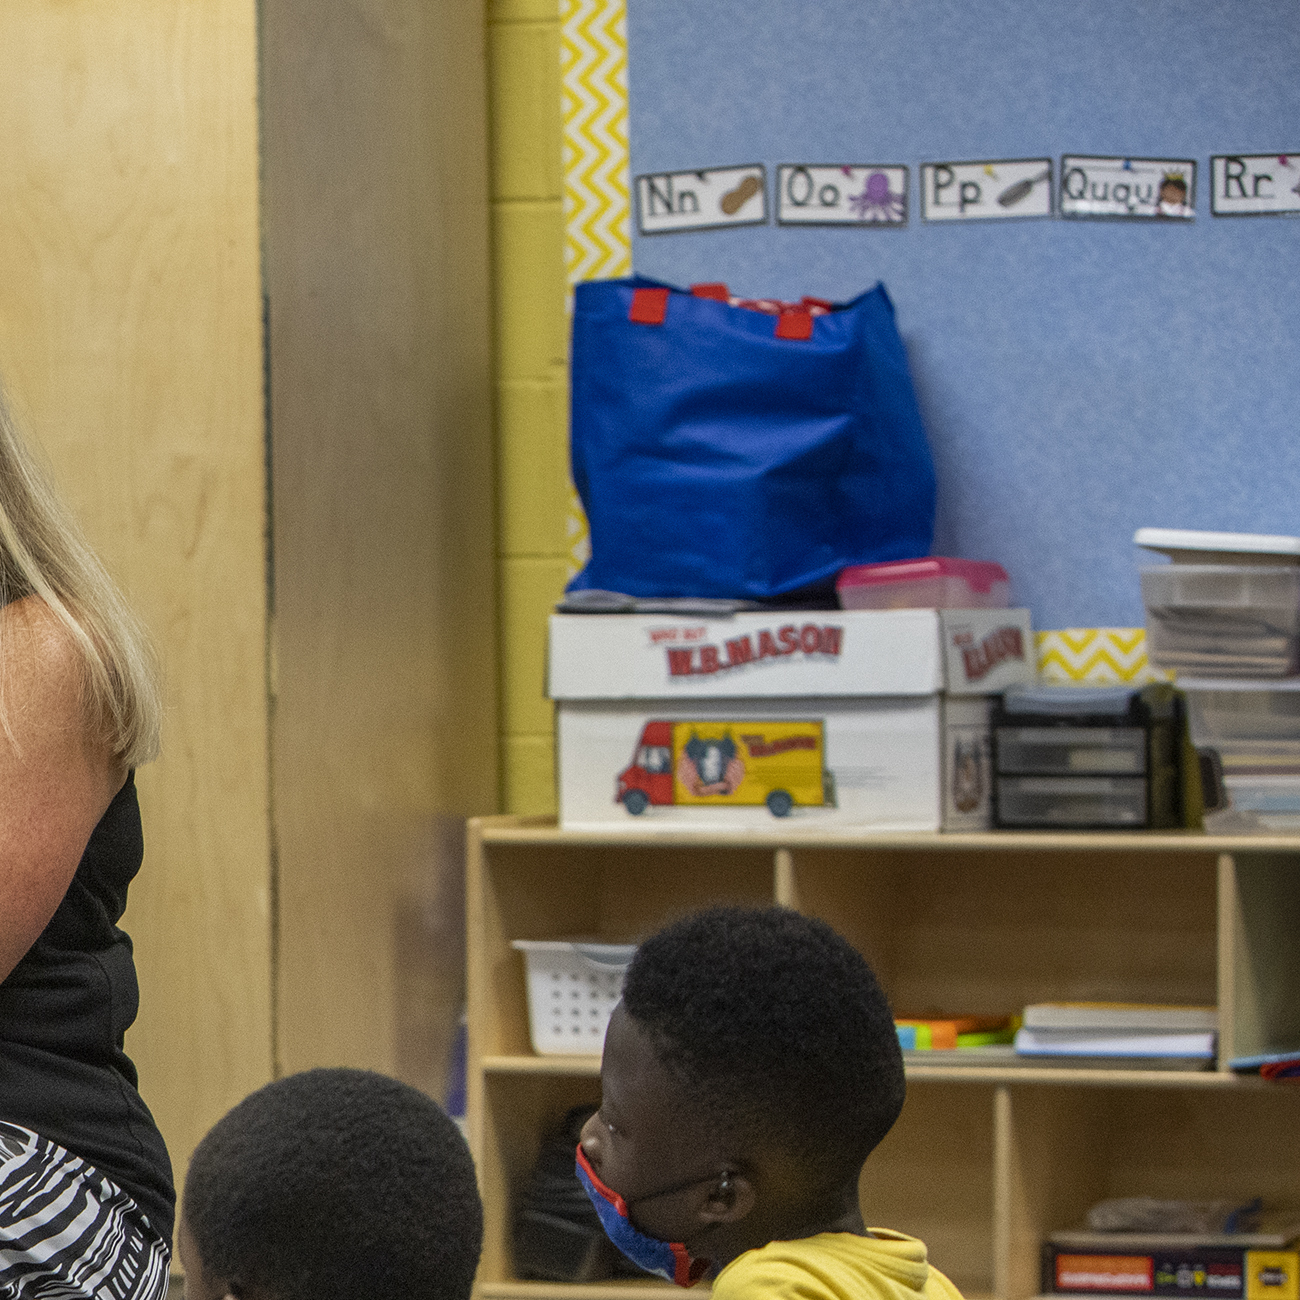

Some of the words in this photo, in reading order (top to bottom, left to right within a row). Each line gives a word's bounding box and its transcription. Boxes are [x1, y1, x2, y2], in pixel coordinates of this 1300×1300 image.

[647, 175, 700, 217] Nn
[786, 165, 841, 207] Oo
[932, 163, 982, 214] Pp
[1224, 156, 1273, 199] Rr
